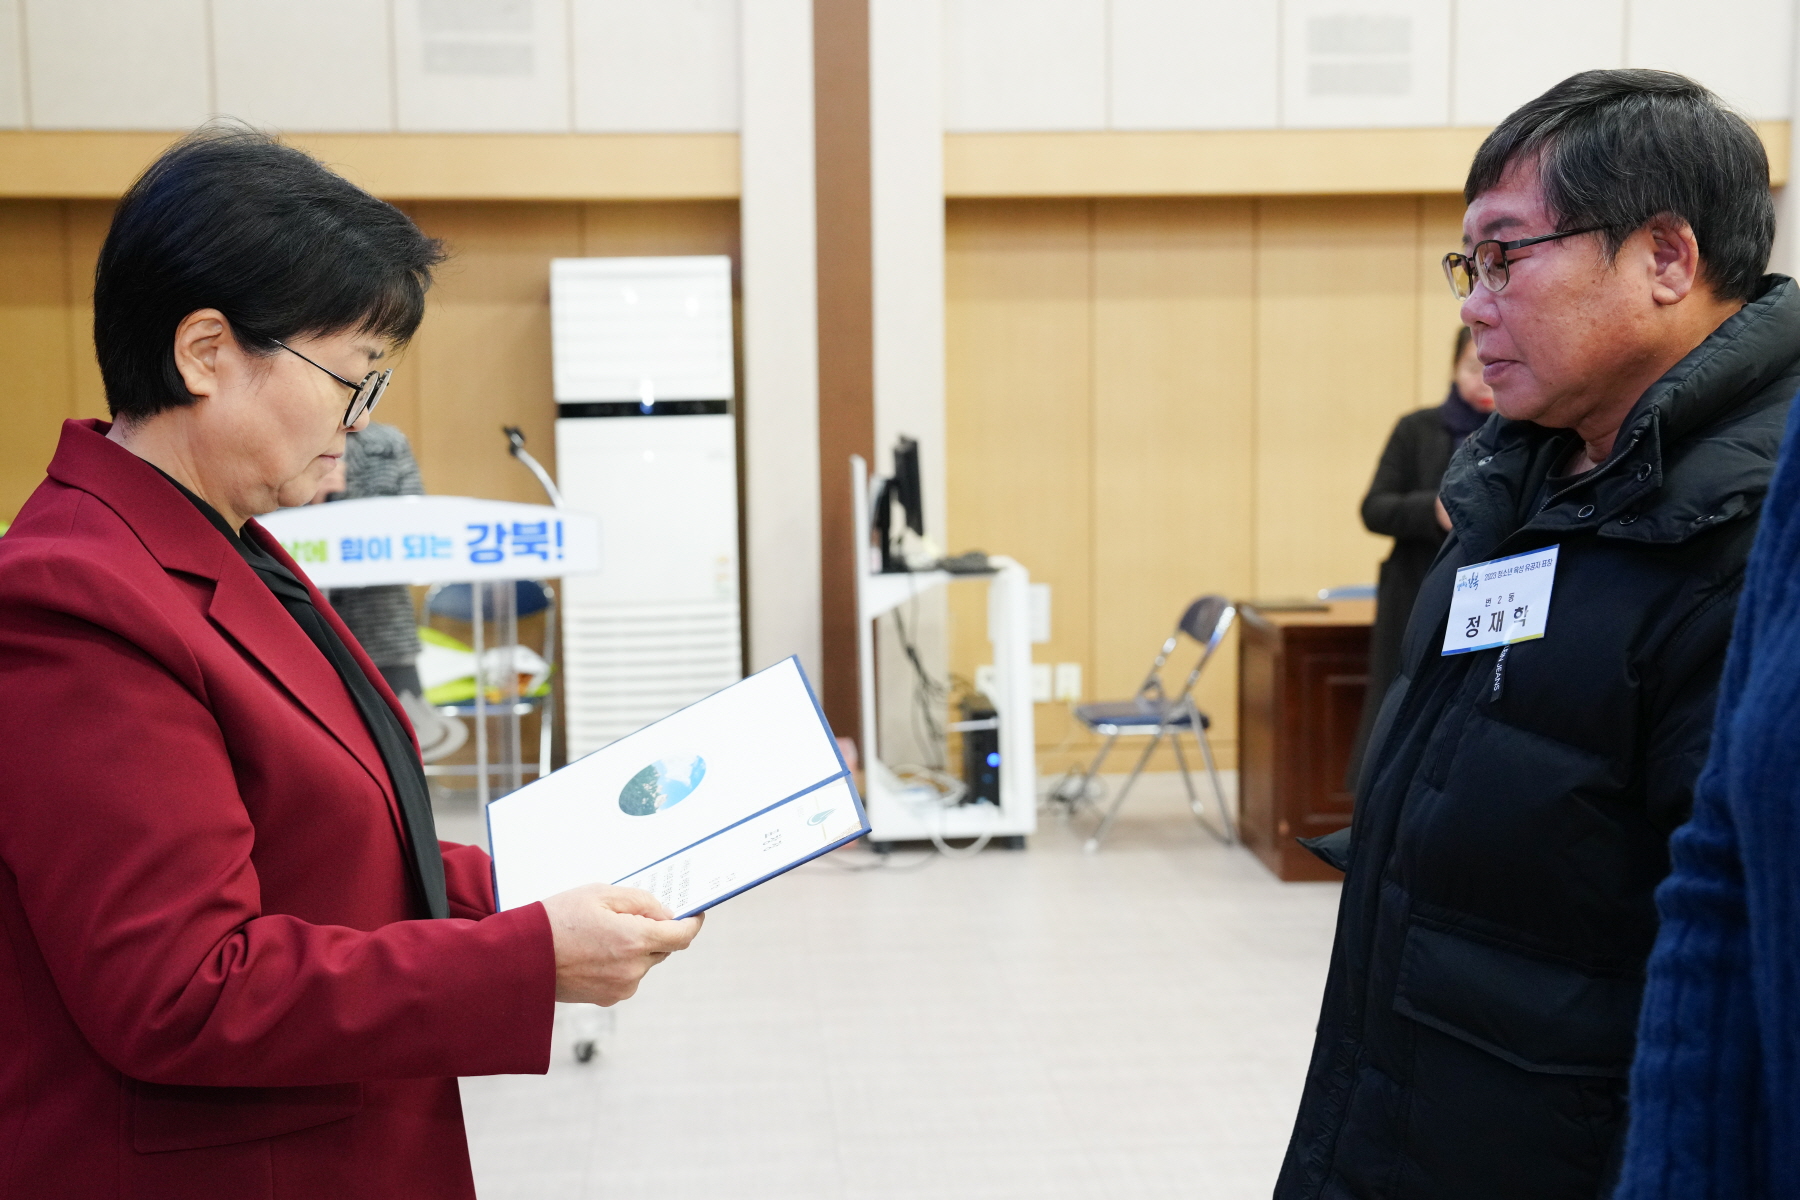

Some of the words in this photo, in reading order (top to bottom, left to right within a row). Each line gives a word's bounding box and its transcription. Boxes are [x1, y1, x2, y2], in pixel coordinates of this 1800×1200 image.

[280, 539, 328, 562] 에
[340, 536, 393, 562] 힘이
[402, 534, 454, 560] 되는
[466, 520, 564, 564] 강북!
[1484, 572, 1497, 581] 2023
[1525, 561, 1541, 572] 유공자
[1541, 558, 1553, 568] 표창
[1498, 645, 1510, 662] LEIN
[1493, 663, 1503, 691] JEANS
